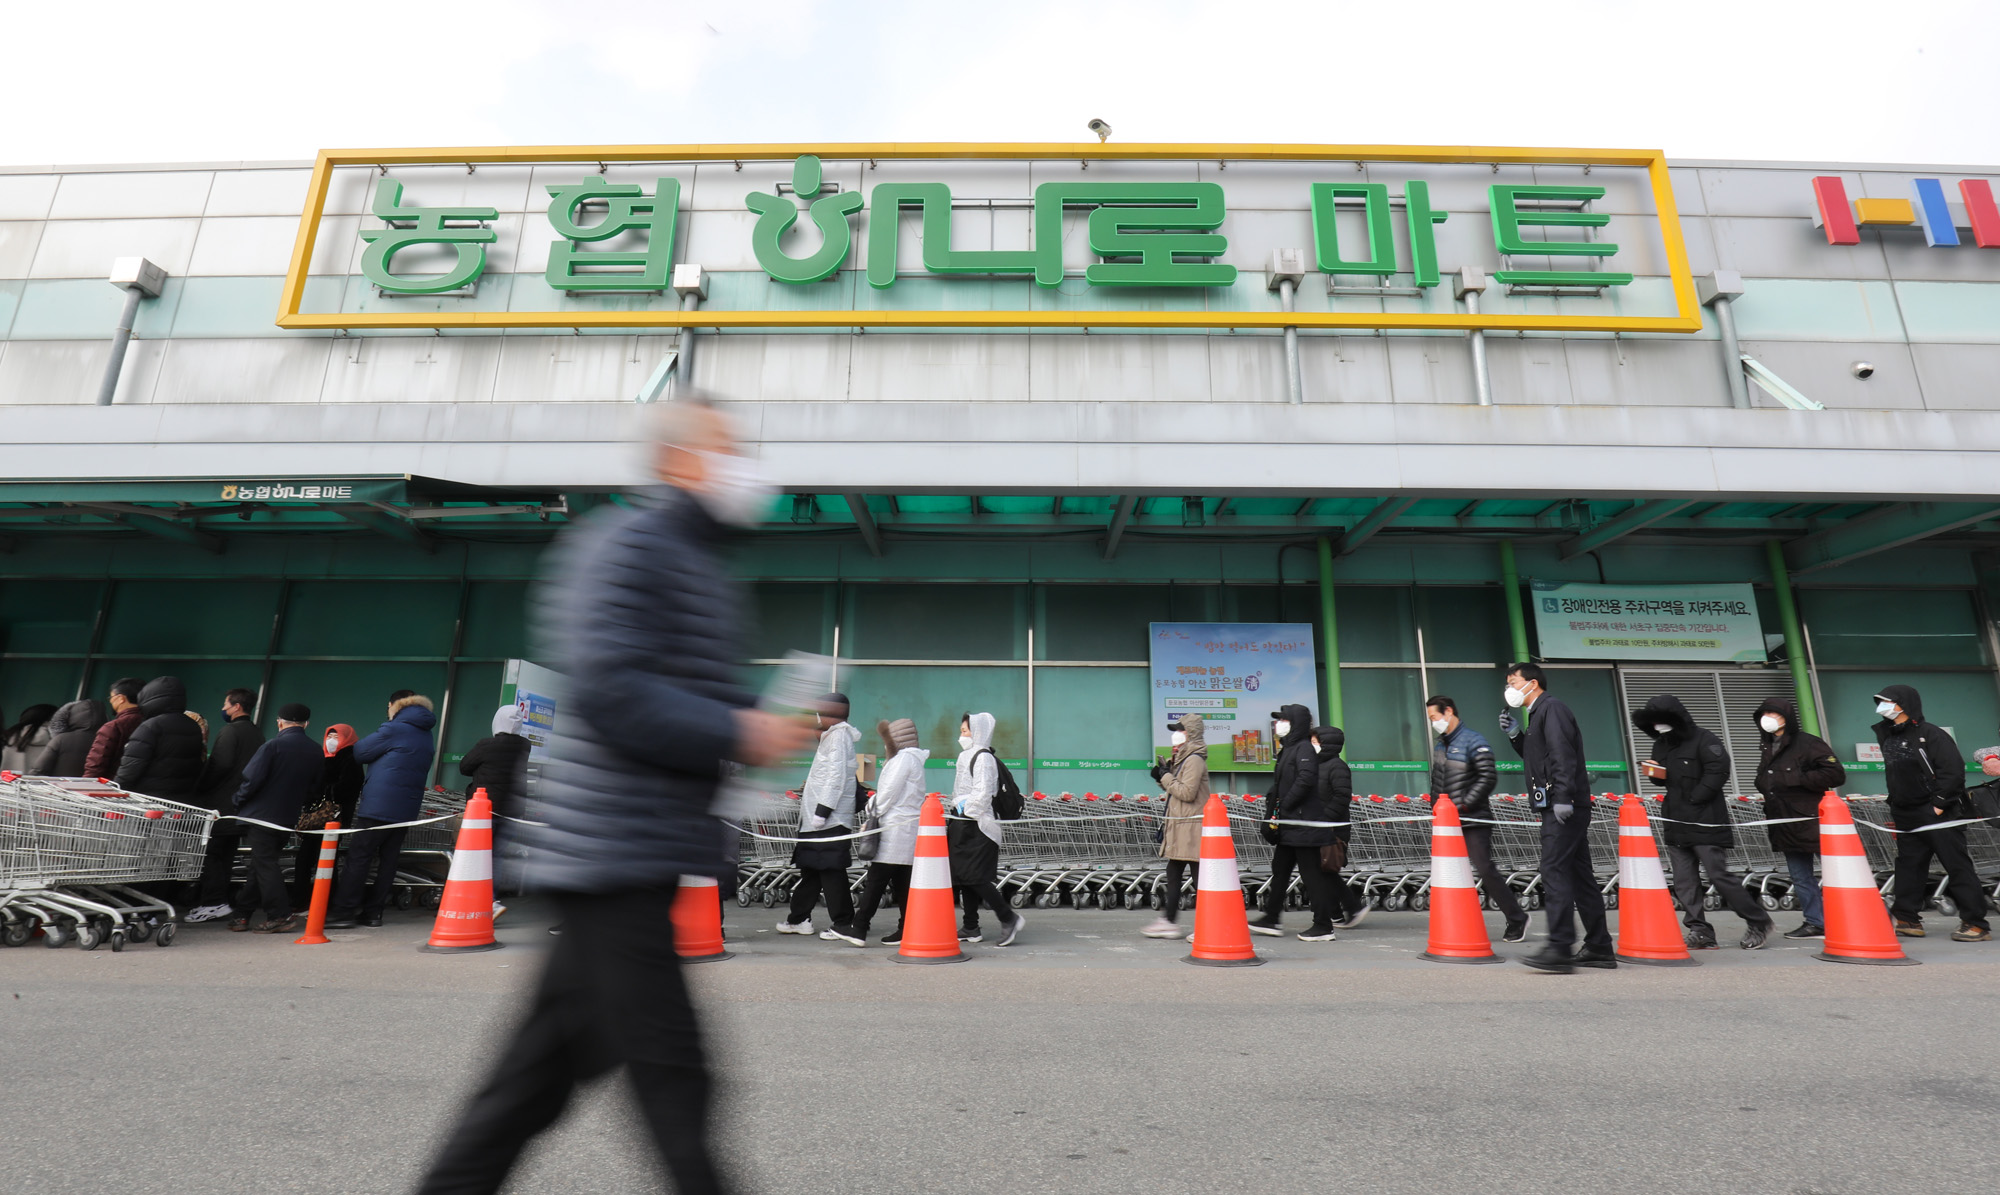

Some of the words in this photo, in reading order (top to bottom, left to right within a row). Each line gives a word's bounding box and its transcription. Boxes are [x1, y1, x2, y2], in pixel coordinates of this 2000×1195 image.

[1561, 598, 1622, 614] 장애인전용
[1625, 600, 1685, 616] 주차구역을
[1689, 601, 1751, 616] 지켜주세요.
[1569, 621, 1609, 631] 불법주차에
[1611, 622, 1627, 631] 대한
[1630, 622, 1653, 632] 서초구
[1655, 623, 1687, 632] 집중단속
[1689, 623, 1730, 633] 기간입니다.
[1156, 680, 1185, 688] 둔포농협
[1188, 680, 1207, 689] 아산
[1210, 677, 1244, 690] 맑은쌀
